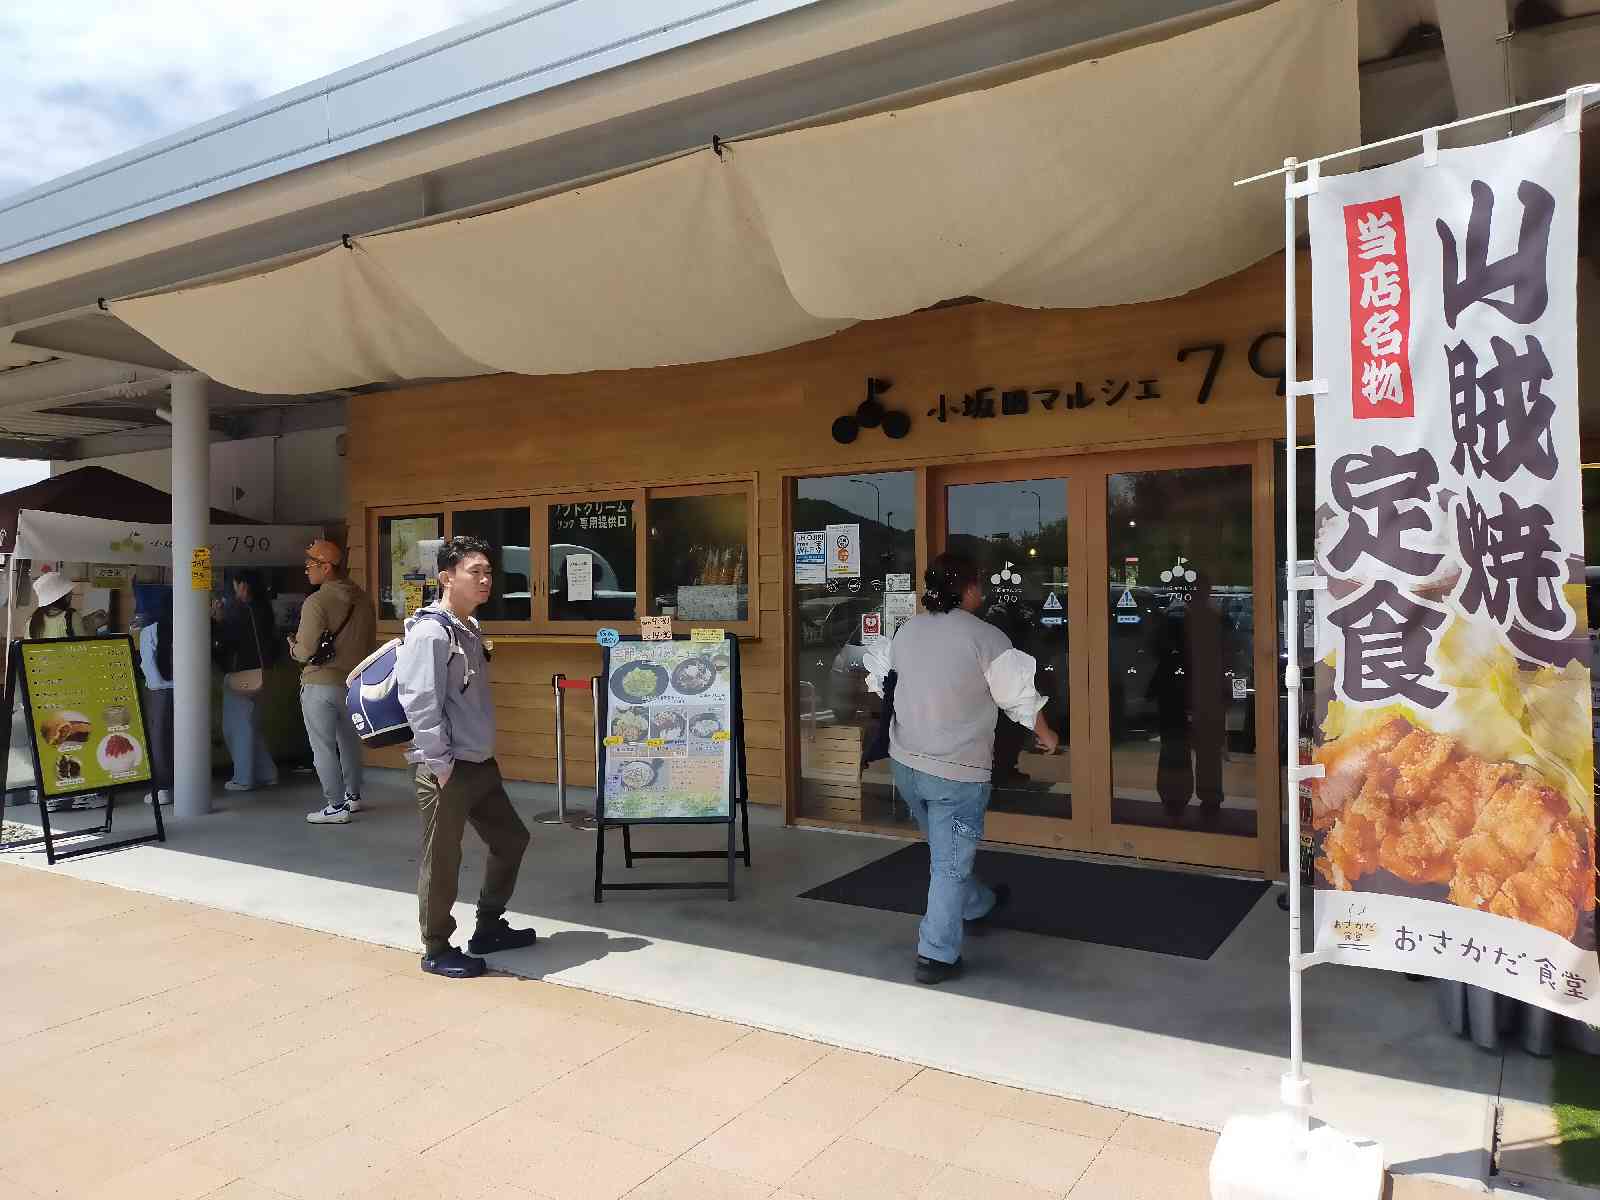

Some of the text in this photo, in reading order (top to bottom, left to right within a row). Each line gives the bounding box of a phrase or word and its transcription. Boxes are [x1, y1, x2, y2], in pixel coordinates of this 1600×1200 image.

[1357, 210, 1404, 406] 当店名物
[1436, 179, 1562, 633] 山賊焼
[227, 534, 272, 554] 790
[1326, 444, 1450, 710] 定食
[1394, 925, 1590, 1001] おさかだ食堂
